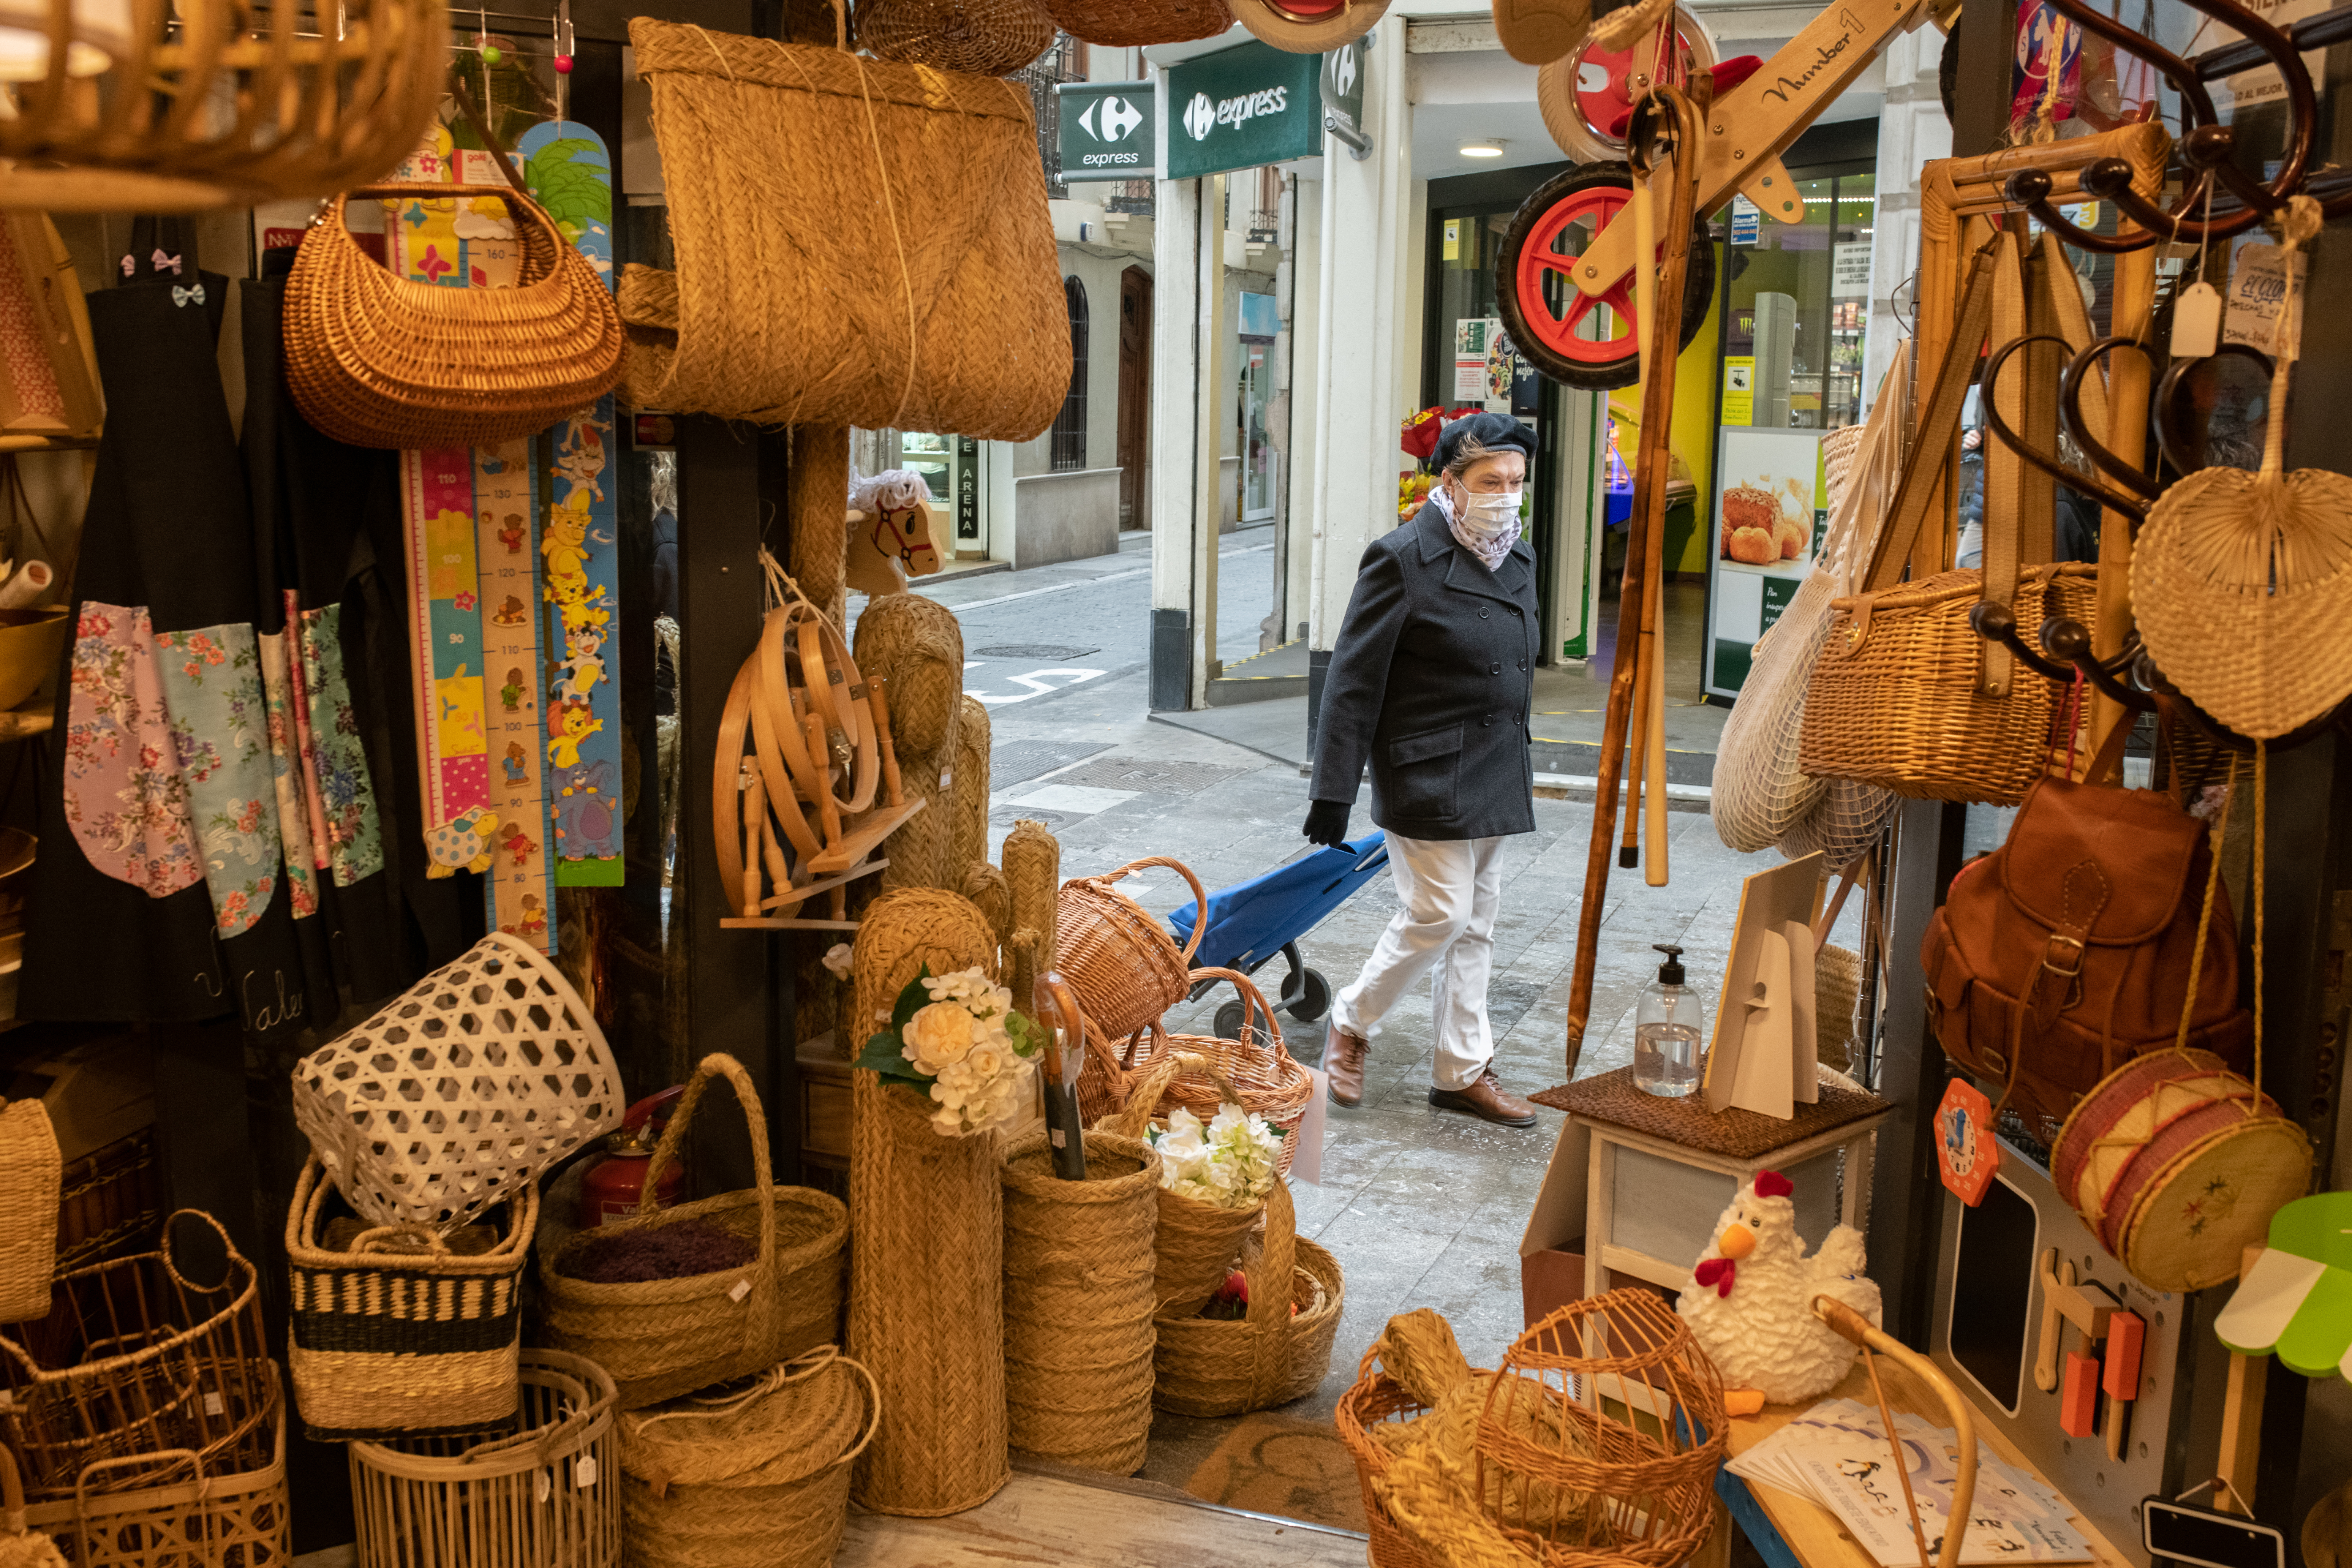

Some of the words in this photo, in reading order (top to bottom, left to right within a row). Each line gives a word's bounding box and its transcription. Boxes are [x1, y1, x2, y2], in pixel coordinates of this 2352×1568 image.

[1762, 32, 1850, 103] Number
[1840, 8, 1865, 34] 1
[2257, 83, 2282, 96] MEJOR
[1217, 86, 1287, 130] express
[1083, 152, 1139, 167] express
[487, 249, 504, 259] 160
[1516, 363, 1535, 381] mejor
[438, 474, 455, 484] 110
[494, 490, 511, 499] 130
[963, 468, 972, 530] ARENA
[443, 555, 462, 564] 100
[498, 569, 515, 578] 120
[1767, 587, 1778, 597] Pan
[449, 634, 464, 644] 90
[502, 646, 519, 654] 110
[505, 722, 522, 732] 100
[510, 798, 522, 808] 90
[514, 874, 526, 883] 80
